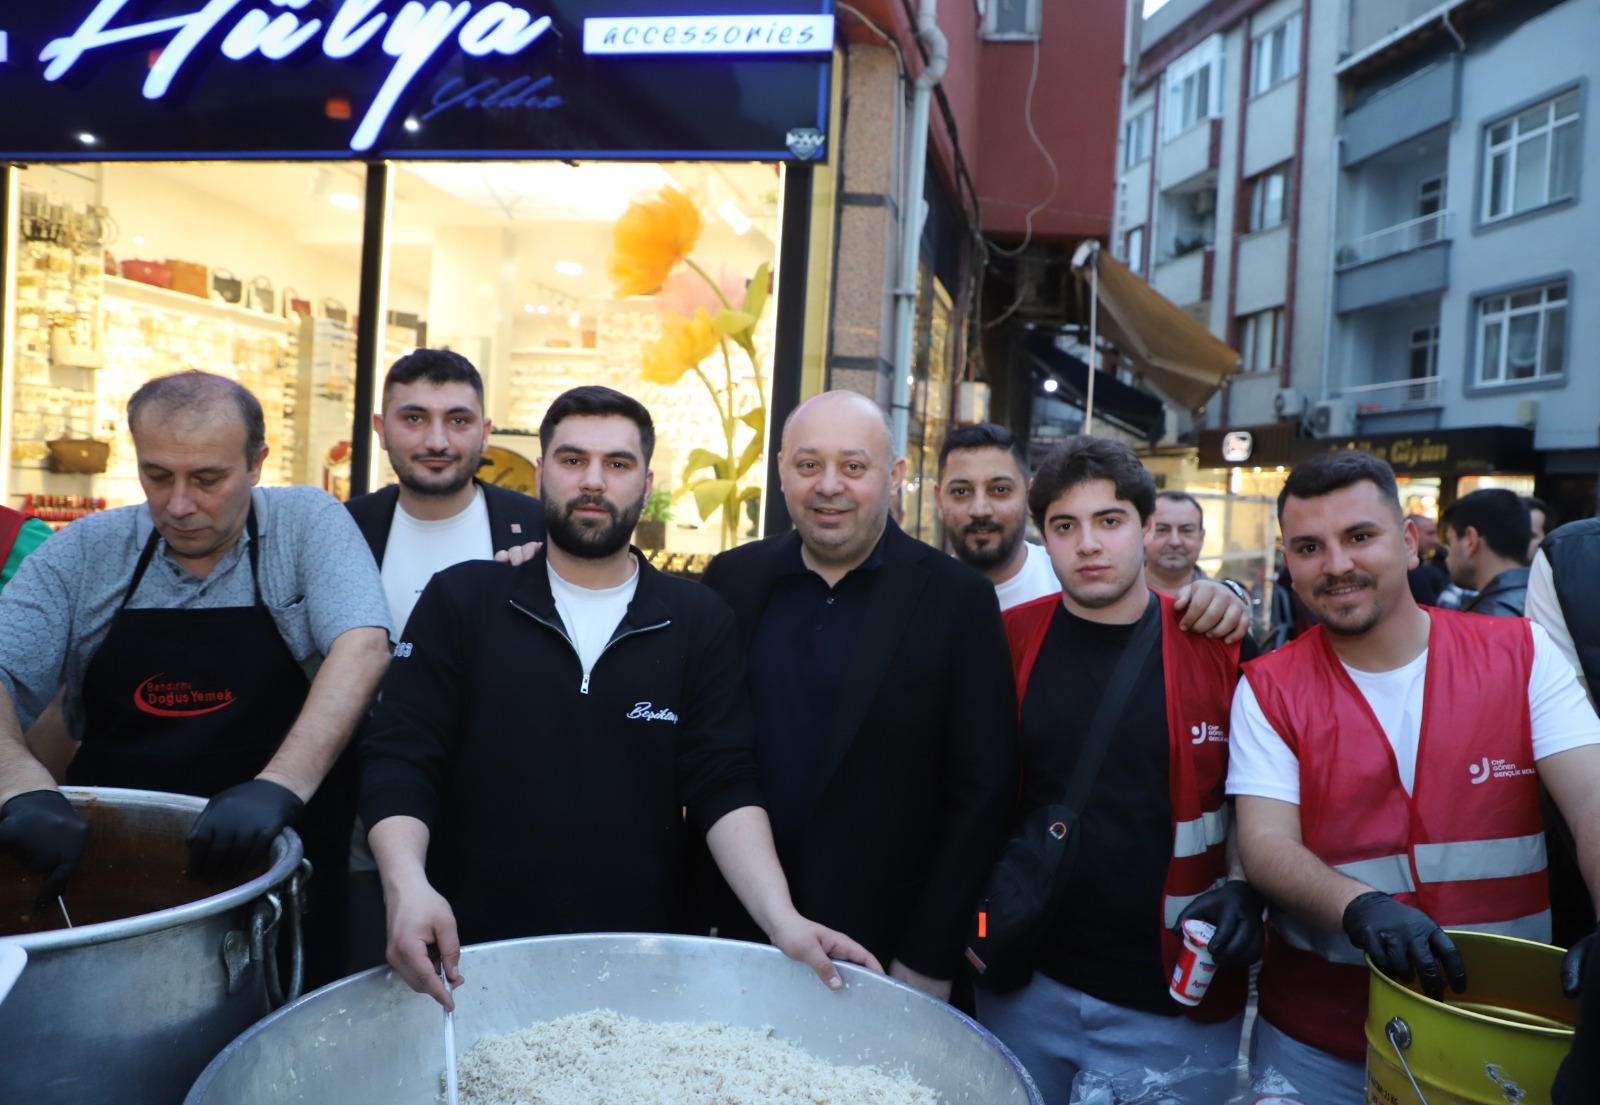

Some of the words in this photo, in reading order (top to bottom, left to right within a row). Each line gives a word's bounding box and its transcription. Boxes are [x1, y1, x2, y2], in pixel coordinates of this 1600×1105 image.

[602, 22, 815, 46] accessories
[148, 691, 190, 706] Doğuş
[190, 689, 233, 702] Yemek
